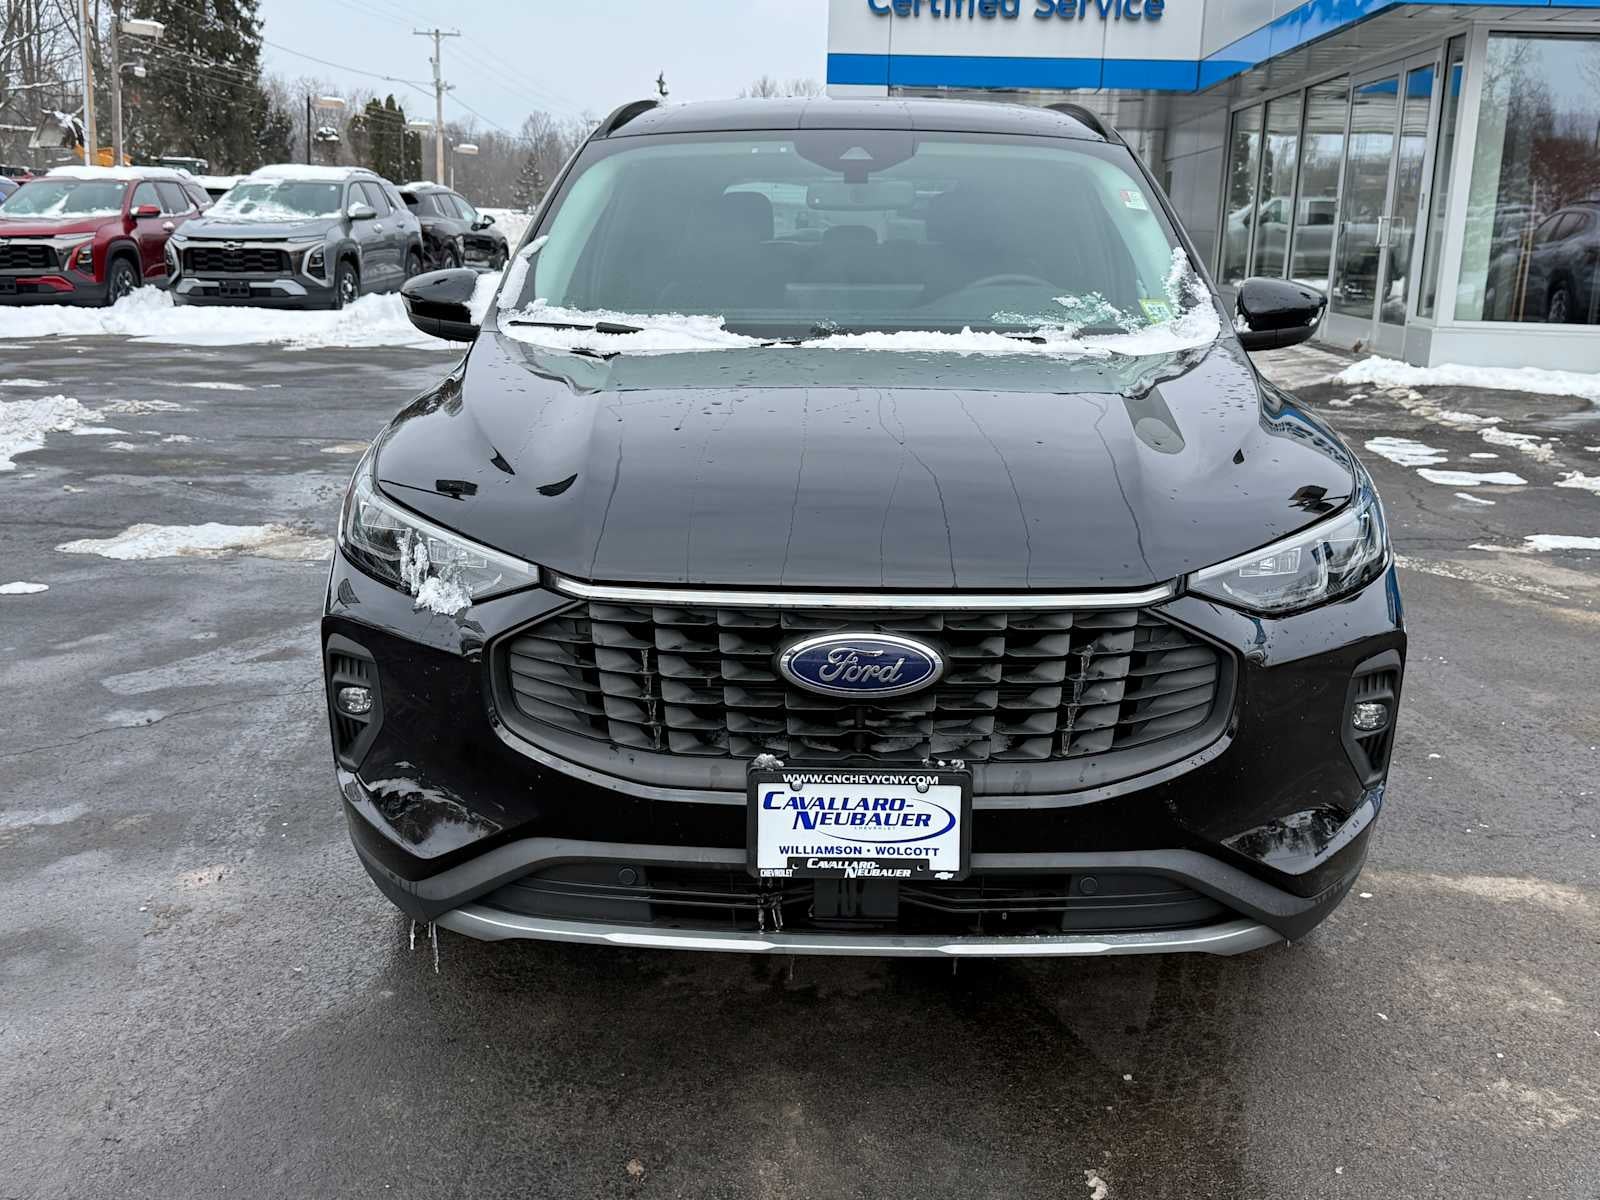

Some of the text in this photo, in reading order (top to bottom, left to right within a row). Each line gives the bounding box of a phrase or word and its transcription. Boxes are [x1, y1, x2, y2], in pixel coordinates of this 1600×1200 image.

[819, 647, 905, 682] Ford
[783, 774, 939, 785] WWW.CNCHEVYCNY.COM
[792, 811, 932, 830] NEUBAUER
[779, 846, 940, 857] WILLIAMSON WOLCOTT
[760, 869, 793, 877] CHEVROLET
[844, 868, 911, 879] NEUBAUER
